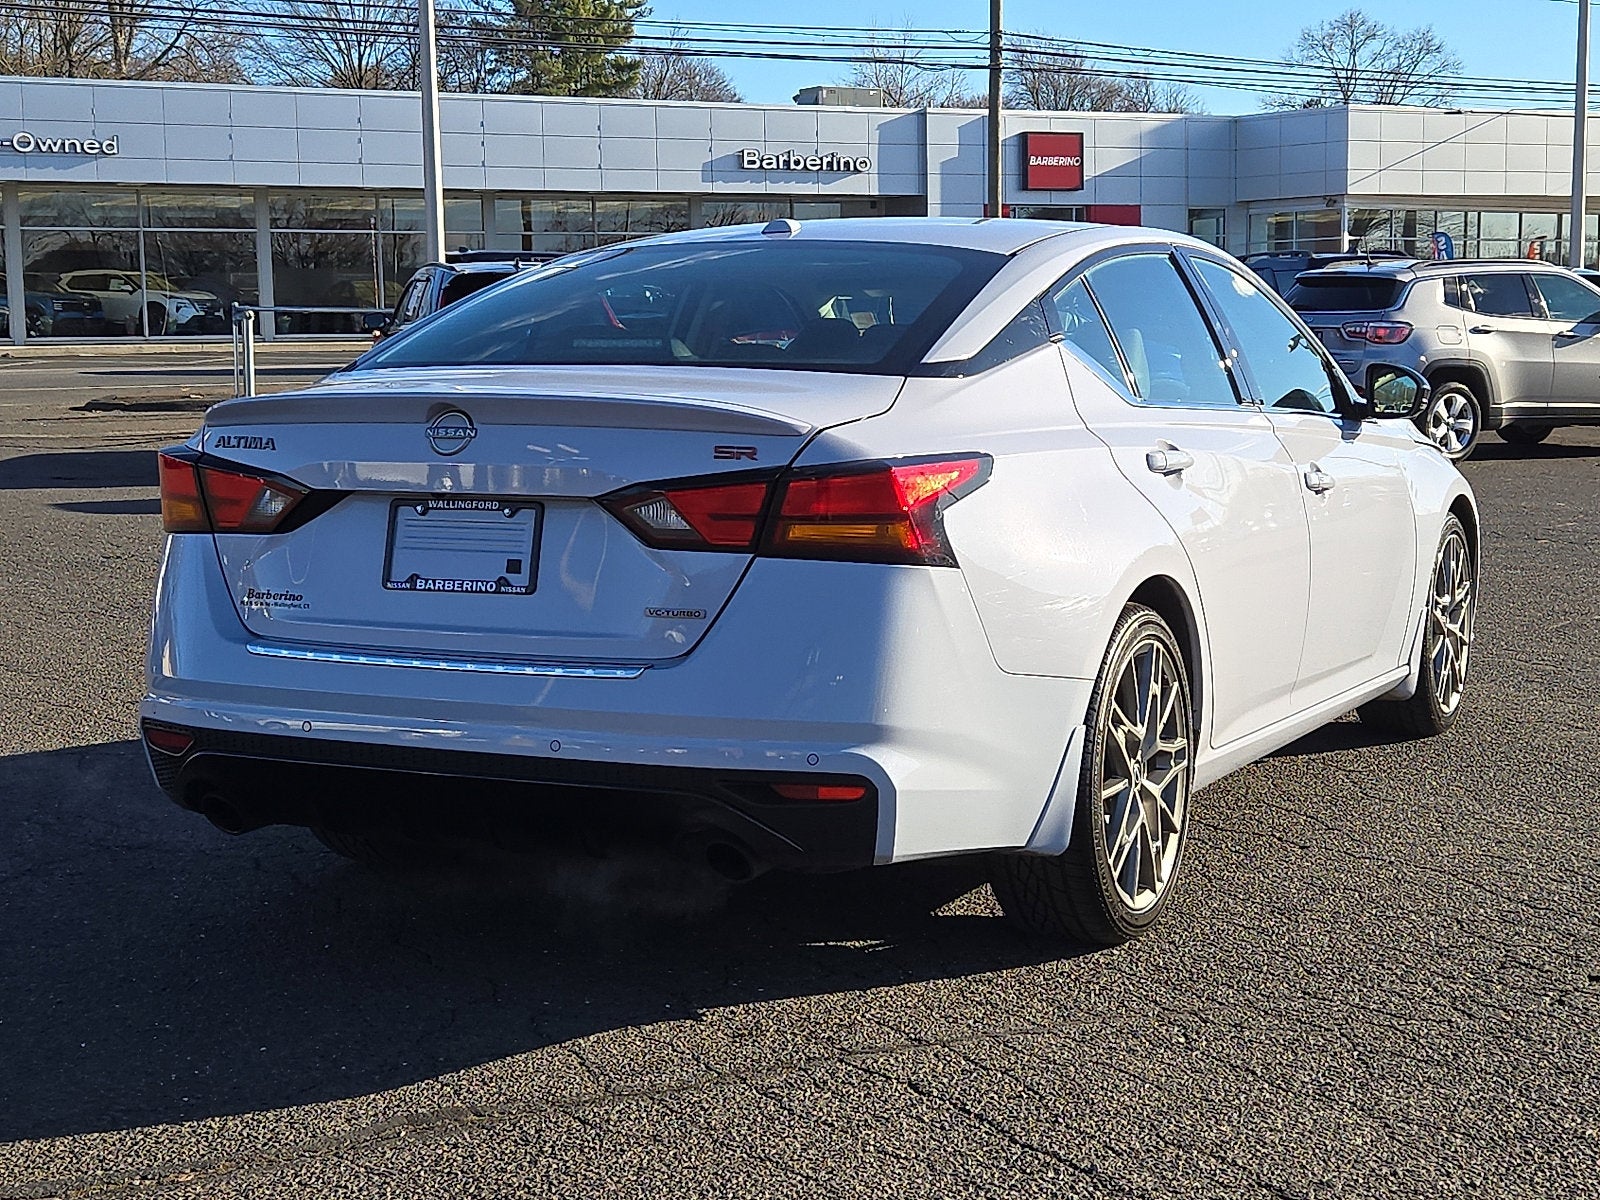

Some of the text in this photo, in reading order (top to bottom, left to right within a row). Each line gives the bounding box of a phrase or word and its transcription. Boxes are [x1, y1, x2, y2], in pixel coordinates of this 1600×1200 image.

[0, 131, 119, 155] -Owned
[742, 148, 872, 173] Barberino
[1029, 155, 1082, 167] BARBERINO
[426, 427, 476, 438] NISSAN
[214, 435, 277, 451] ALTIMA
[713, 445, 758, 461] SR
[427, 499, 500, 511] WALLINGFORD
[415, 579, 497, 593] BARBERINO
[247, 587, 304, 602] Barberino
